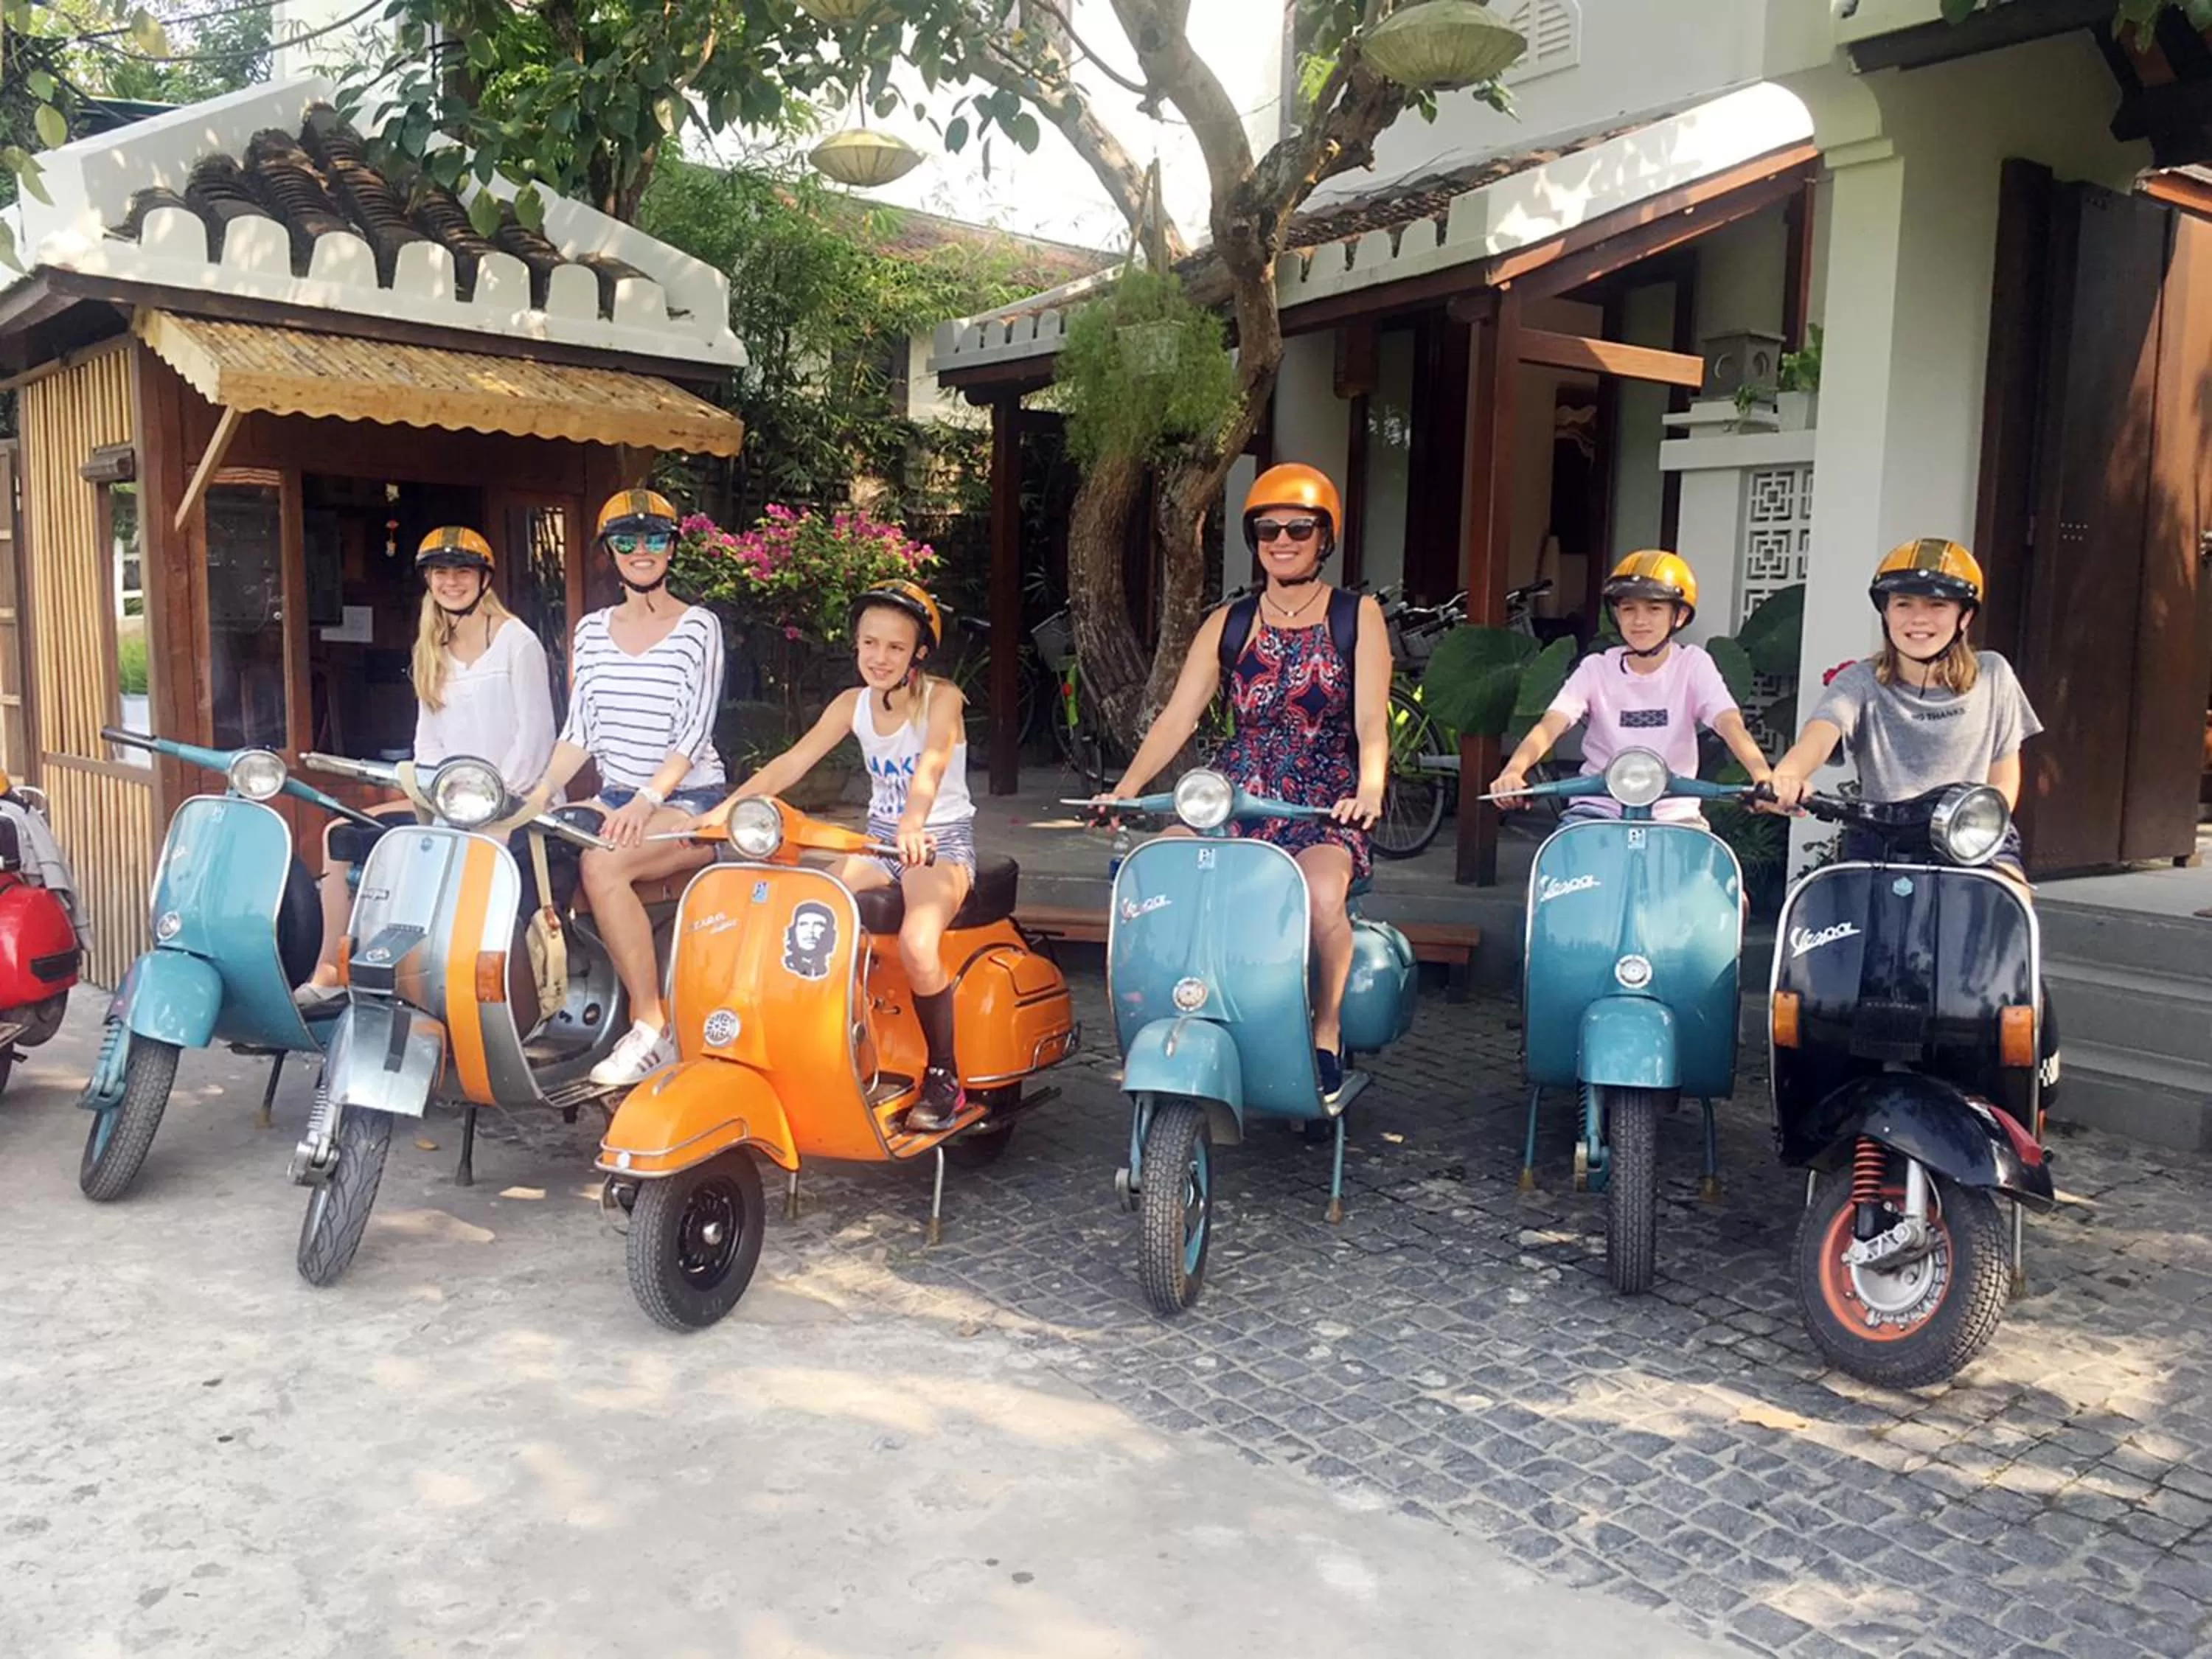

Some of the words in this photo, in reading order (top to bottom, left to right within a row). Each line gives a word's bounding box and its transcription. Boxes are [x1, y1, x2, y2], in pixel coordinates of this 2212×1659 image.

[1926, 707, 1966, 720] THANKS
[1539, 874, 1601, 902] Vespa
[1790, 921, 1861, 958] Vespa
